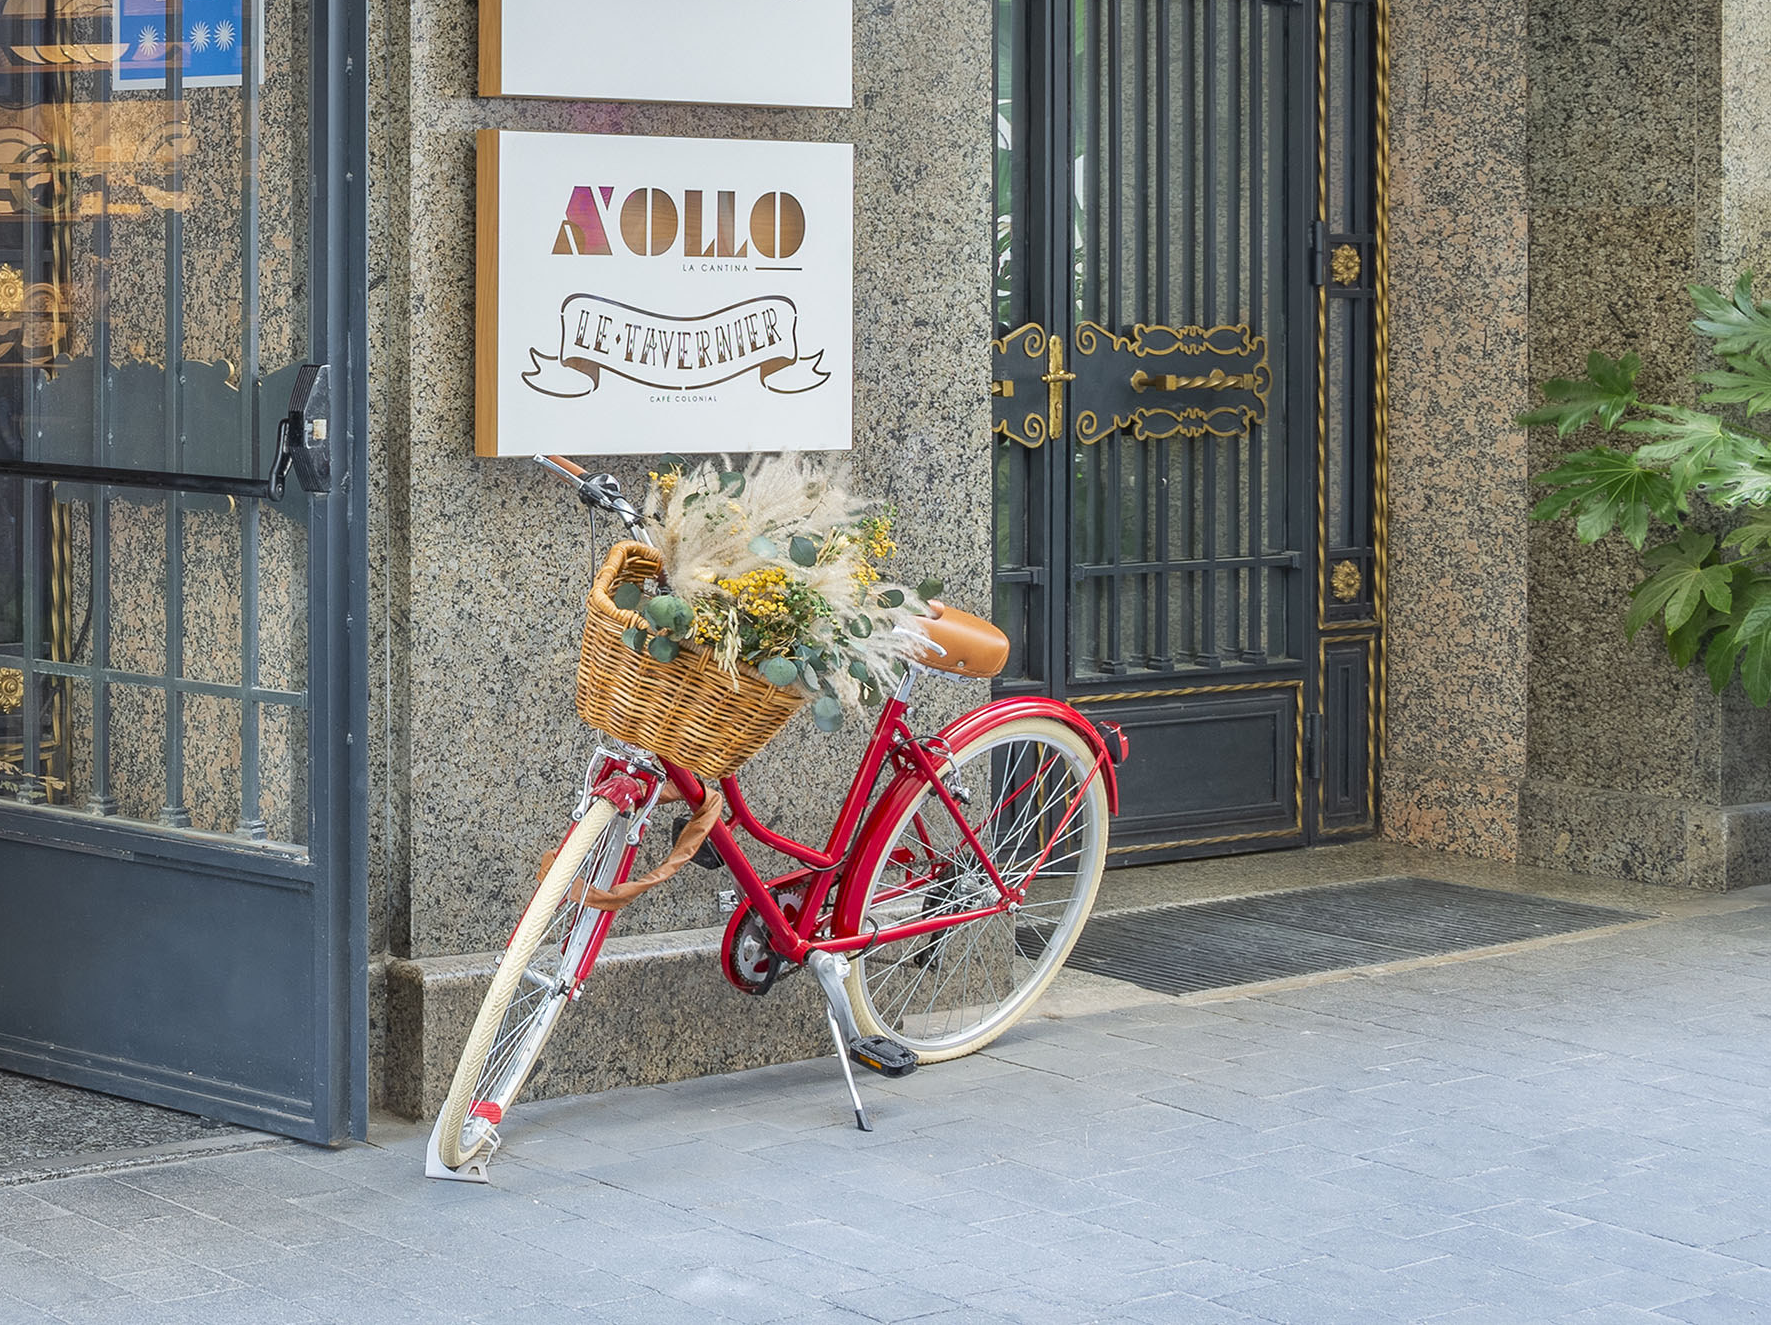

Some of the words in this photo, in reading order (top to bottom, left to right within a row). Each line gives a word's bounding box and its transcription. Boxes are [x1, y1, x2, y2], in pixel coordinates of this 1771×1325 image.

[682, 264, 695, 272] LA
[701, 263, 749, 272] CANTINA
[649, 395, 670, 403] CAFÉ
[674, 395, 718, 403] COLONIAL
